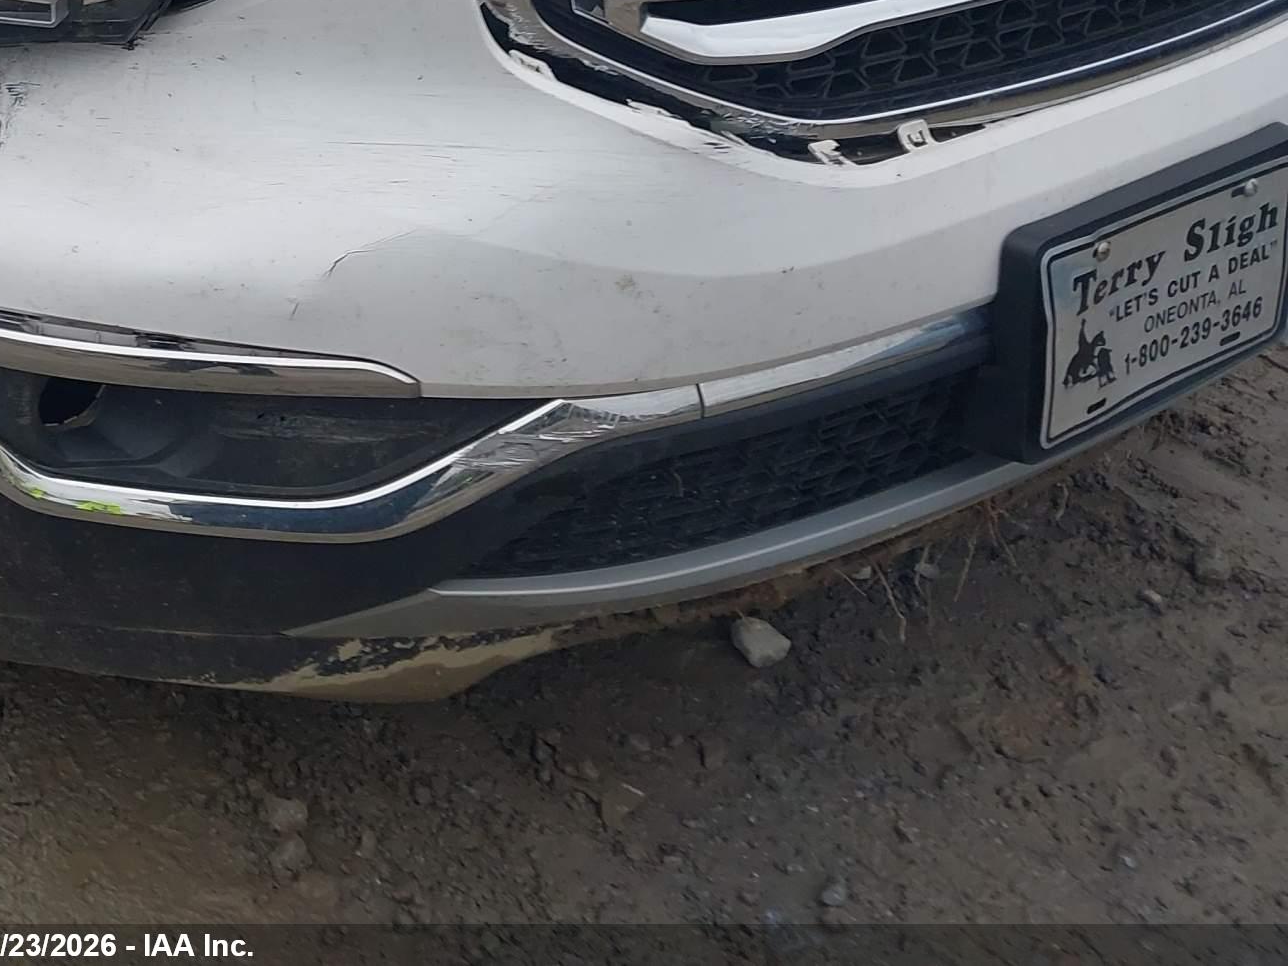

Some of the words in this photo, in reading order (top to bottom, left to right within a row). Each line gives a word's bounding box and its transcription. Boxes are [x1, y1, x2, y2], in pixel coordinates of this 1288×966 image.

[1073, 250, 1166, 316] Terry
[1184, 202, 1279, 263] Sligh
[1167, 271, 1202, 298] CUT
[1208, 264, 1220, 283] A
[1228, 279, 1247, 299] AL
[1124, 296, 1264, 376] 1-800-239-3646
